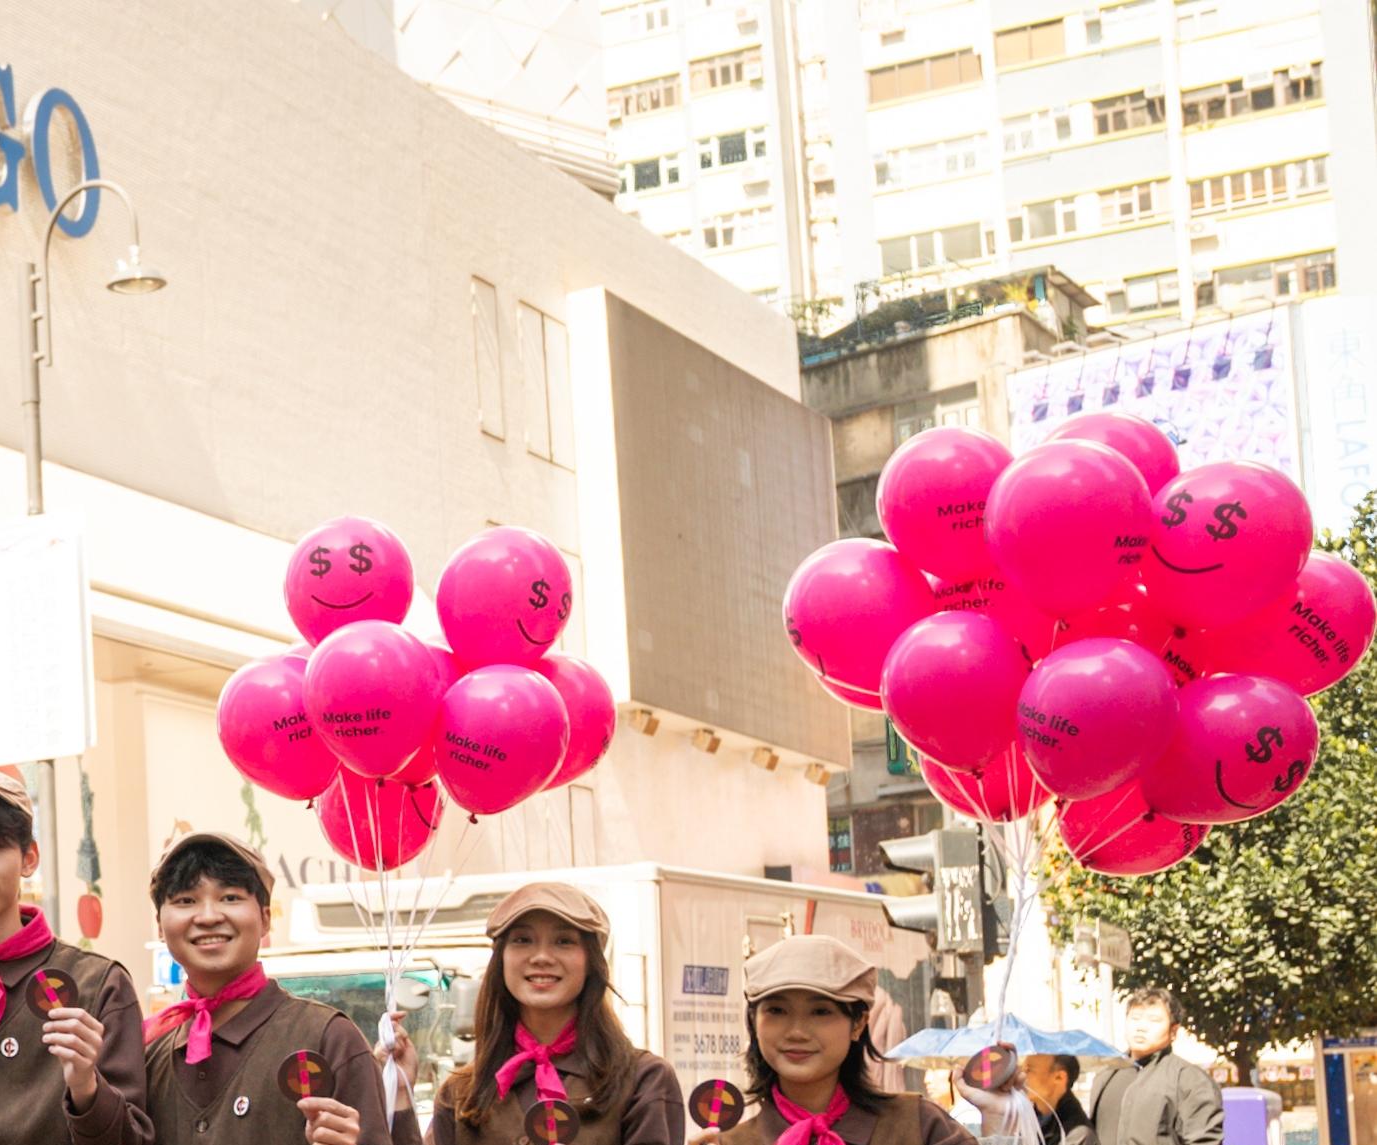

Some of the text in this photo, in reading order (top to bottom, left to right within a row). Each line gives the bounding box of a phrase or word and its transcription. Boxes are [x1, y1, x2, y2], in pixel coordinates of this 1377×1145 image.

[952, 515, 985, 532] rich
[1161, 489, 1248, 542] $ $
[309, 541, 374, 579] $ $
[528, 578, 552, 611] $
[1290, 600, 1337, 641] Make
[273, 711, 308, 732] Mak
[322, 707, 392, 725] Make life
[1049, 713, 1080, 737] life
[445, 730, 509, 763] Make life
[1246, 726, 1308, 792] $ $
